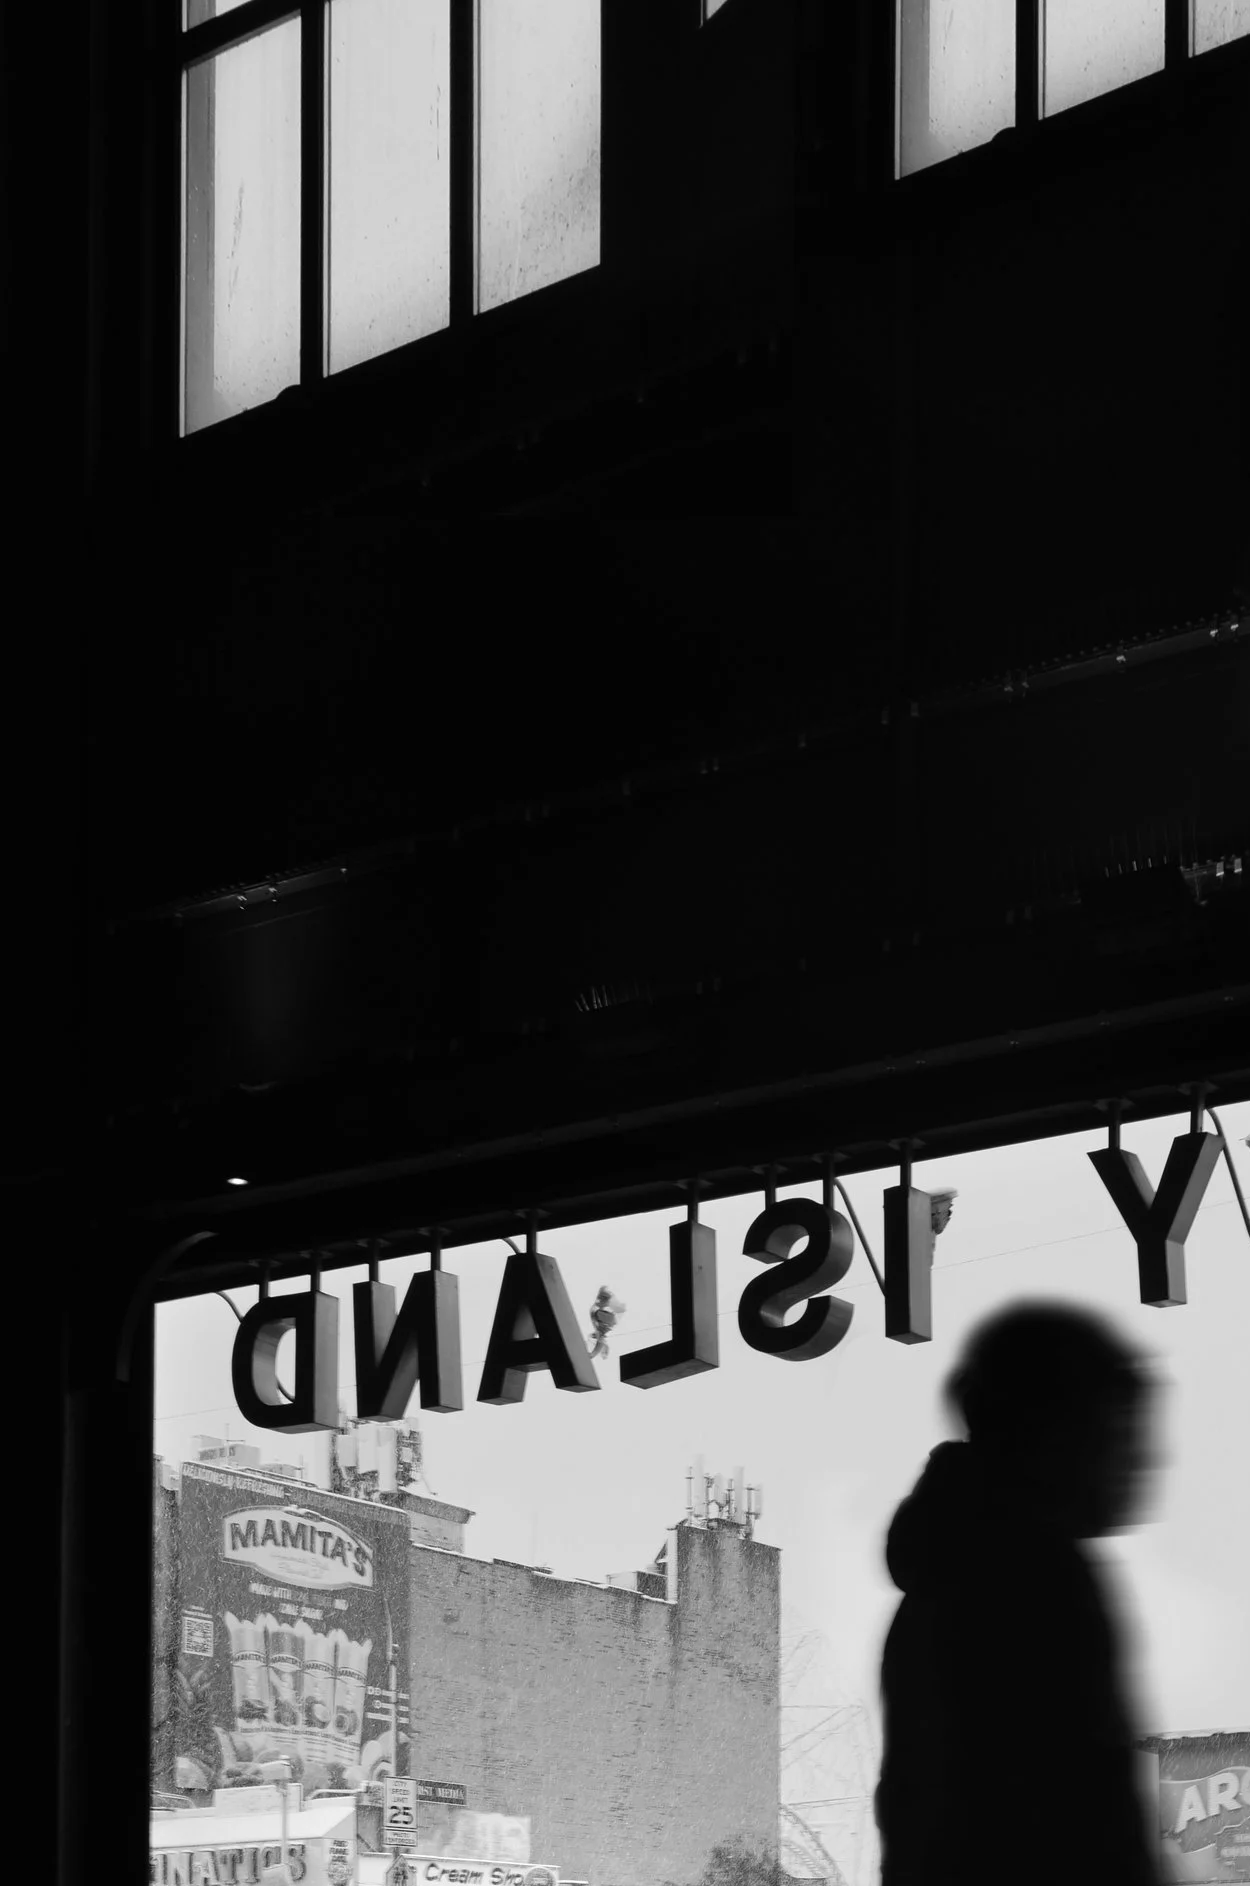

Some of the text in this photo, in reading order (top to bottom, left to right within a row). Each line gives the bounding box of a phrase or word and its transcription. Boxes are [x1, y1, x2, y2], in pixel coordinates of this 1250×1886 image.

[229, 1518, 372, 1578] MAMITA'S
[388, 1805, 414, 1825] 25
[425, 1862, 484, 1885] Cream
